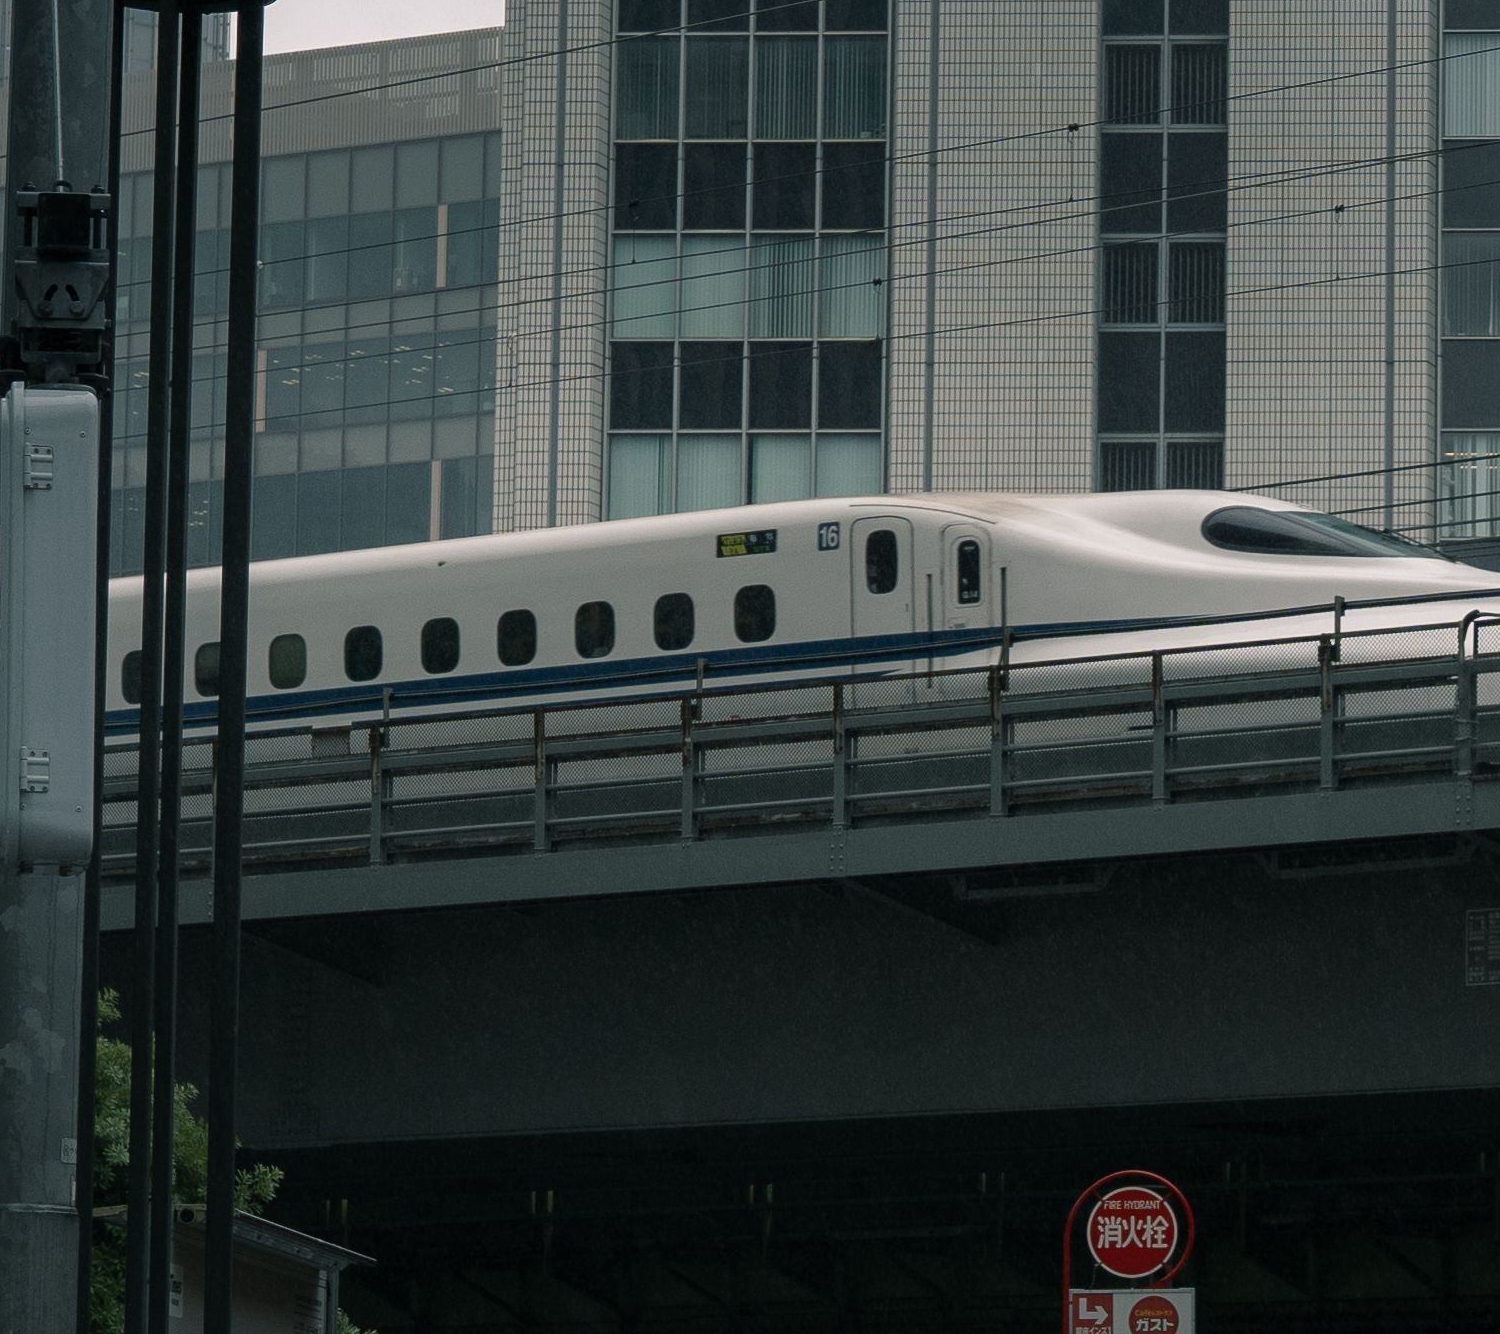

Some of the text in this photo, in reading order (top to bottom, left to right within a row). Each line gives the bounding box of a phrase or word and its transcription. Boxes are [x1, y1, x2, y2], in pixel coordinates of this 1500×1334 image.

[819, 525, 839, 548] 16
[1104, 1200, 1122, 1210] FIRE
[1097, 1215, 1169, 1249] 消火栓
[1136, 1317, 1175, 1332] ガスト
